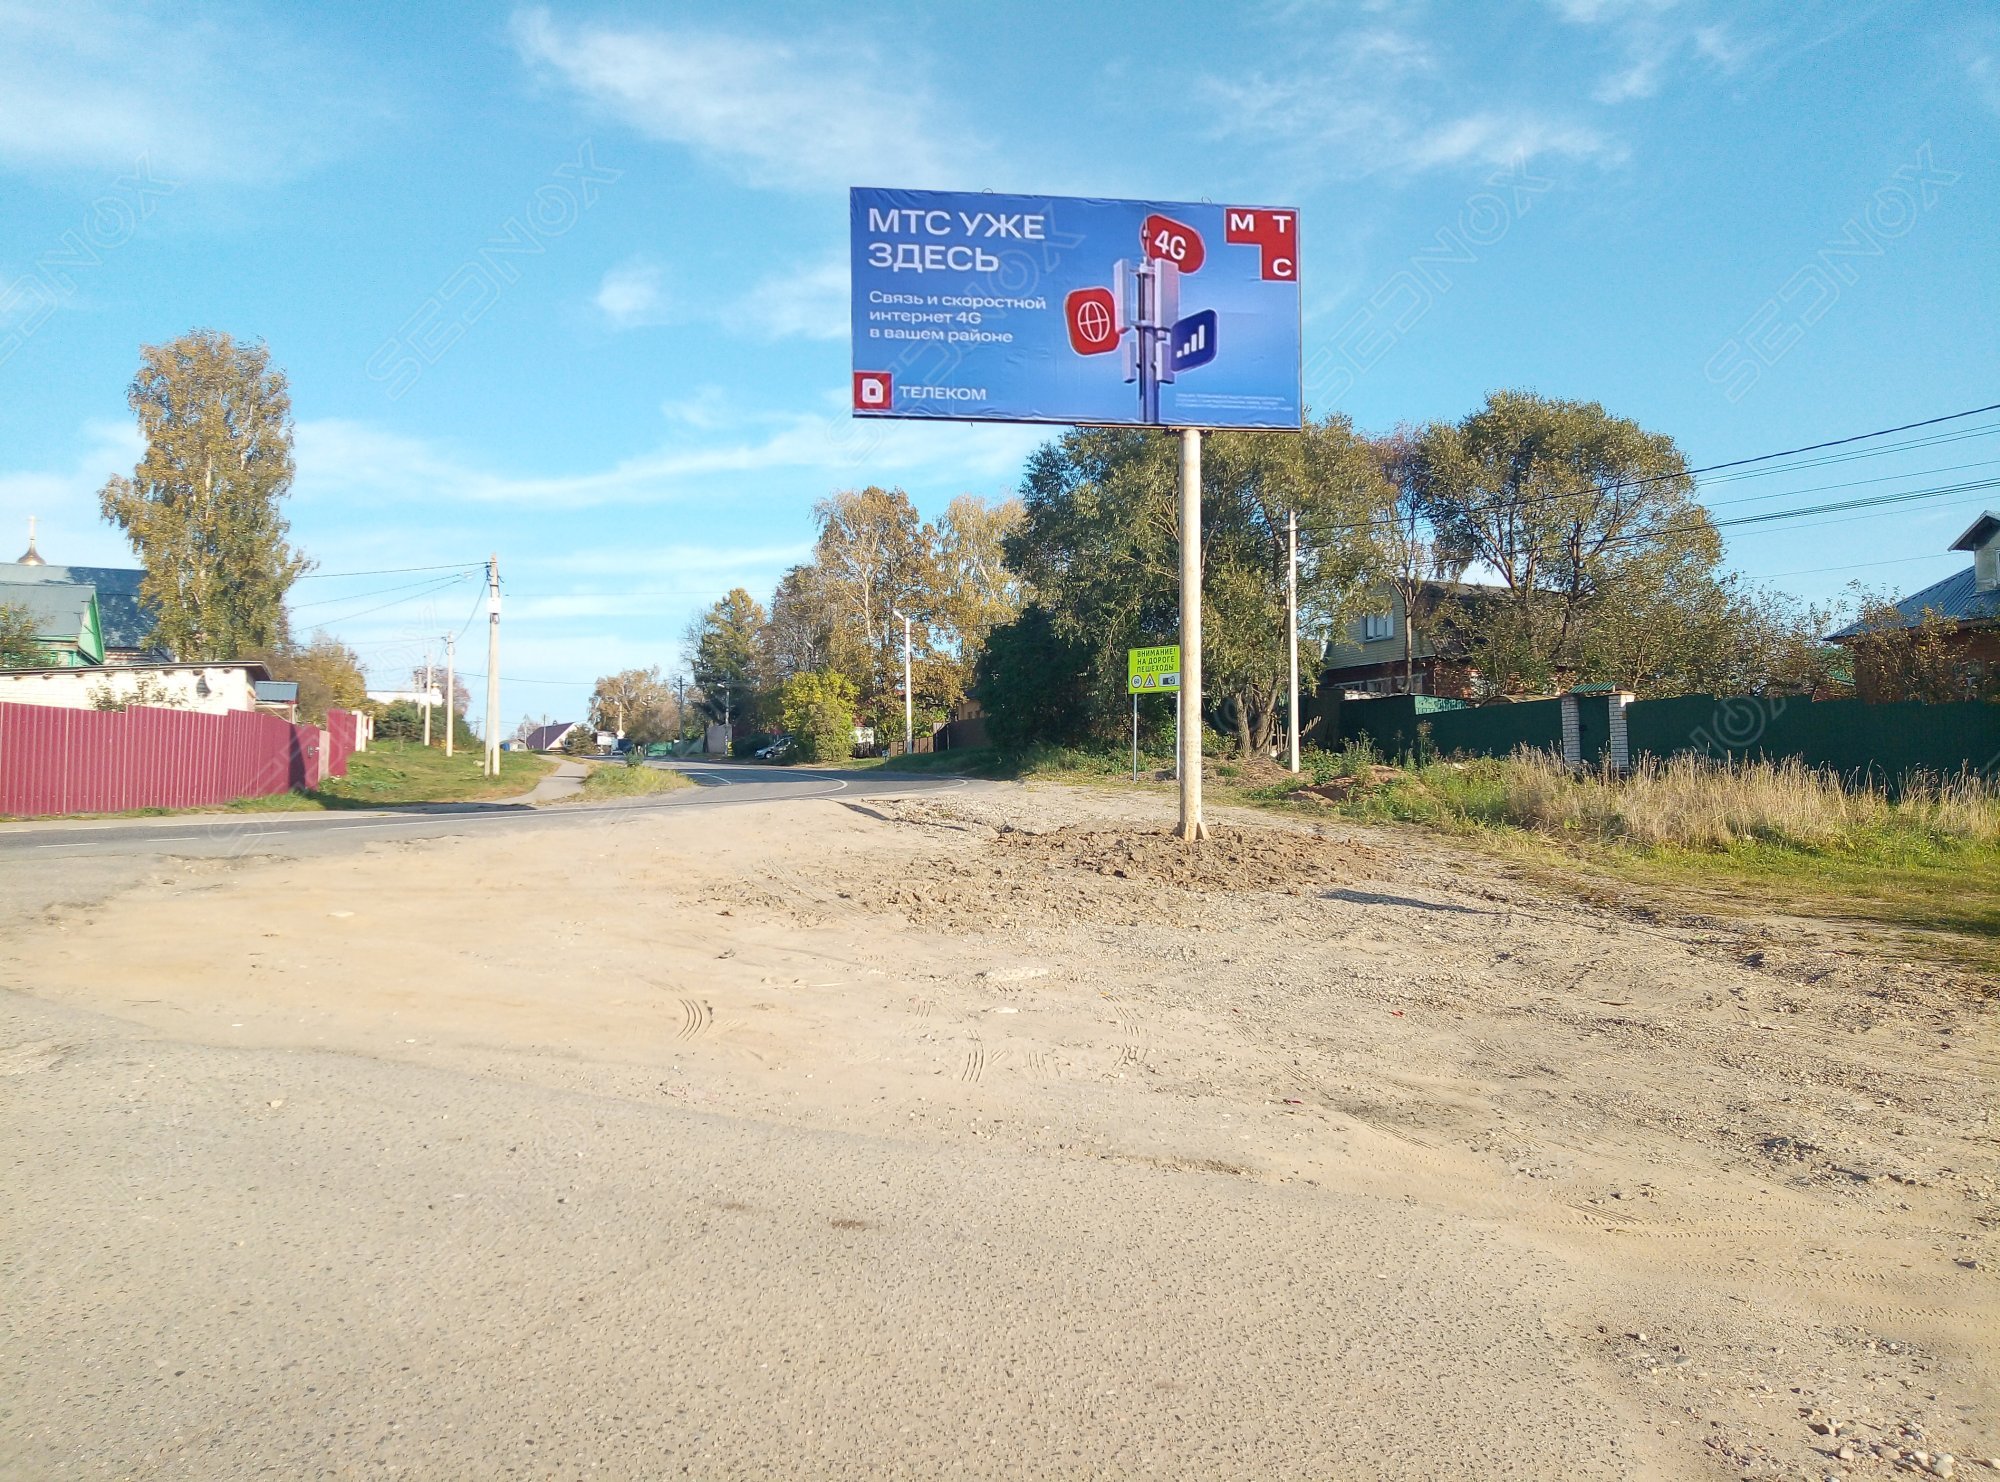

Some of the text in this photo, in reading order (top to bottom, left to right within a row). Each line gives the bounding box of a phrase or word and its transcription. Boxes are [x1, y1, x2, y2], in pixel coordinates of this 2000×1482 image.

[869, 207, 1046, 240] МТС УЖЕ
[1154, 230, 1187, 260] 4G
[868, 242, 999, 273] ЗДЕСЬ
[869, 290, 1047, 310] Связь и скоростной
[869, 310, 982, 325] интернет 4G
[869, 328, 1013, 343] в вашем районе
[899, 385, 986, 401] ТЕЛЕКОМ
[1137, 648, 1175, 657] ВНИМАНИЕ!
[1137, 664, 1173, 672] ПЕШЕХОДЫ
[1149, 656, 1174, 665] ДОРОГЕ
